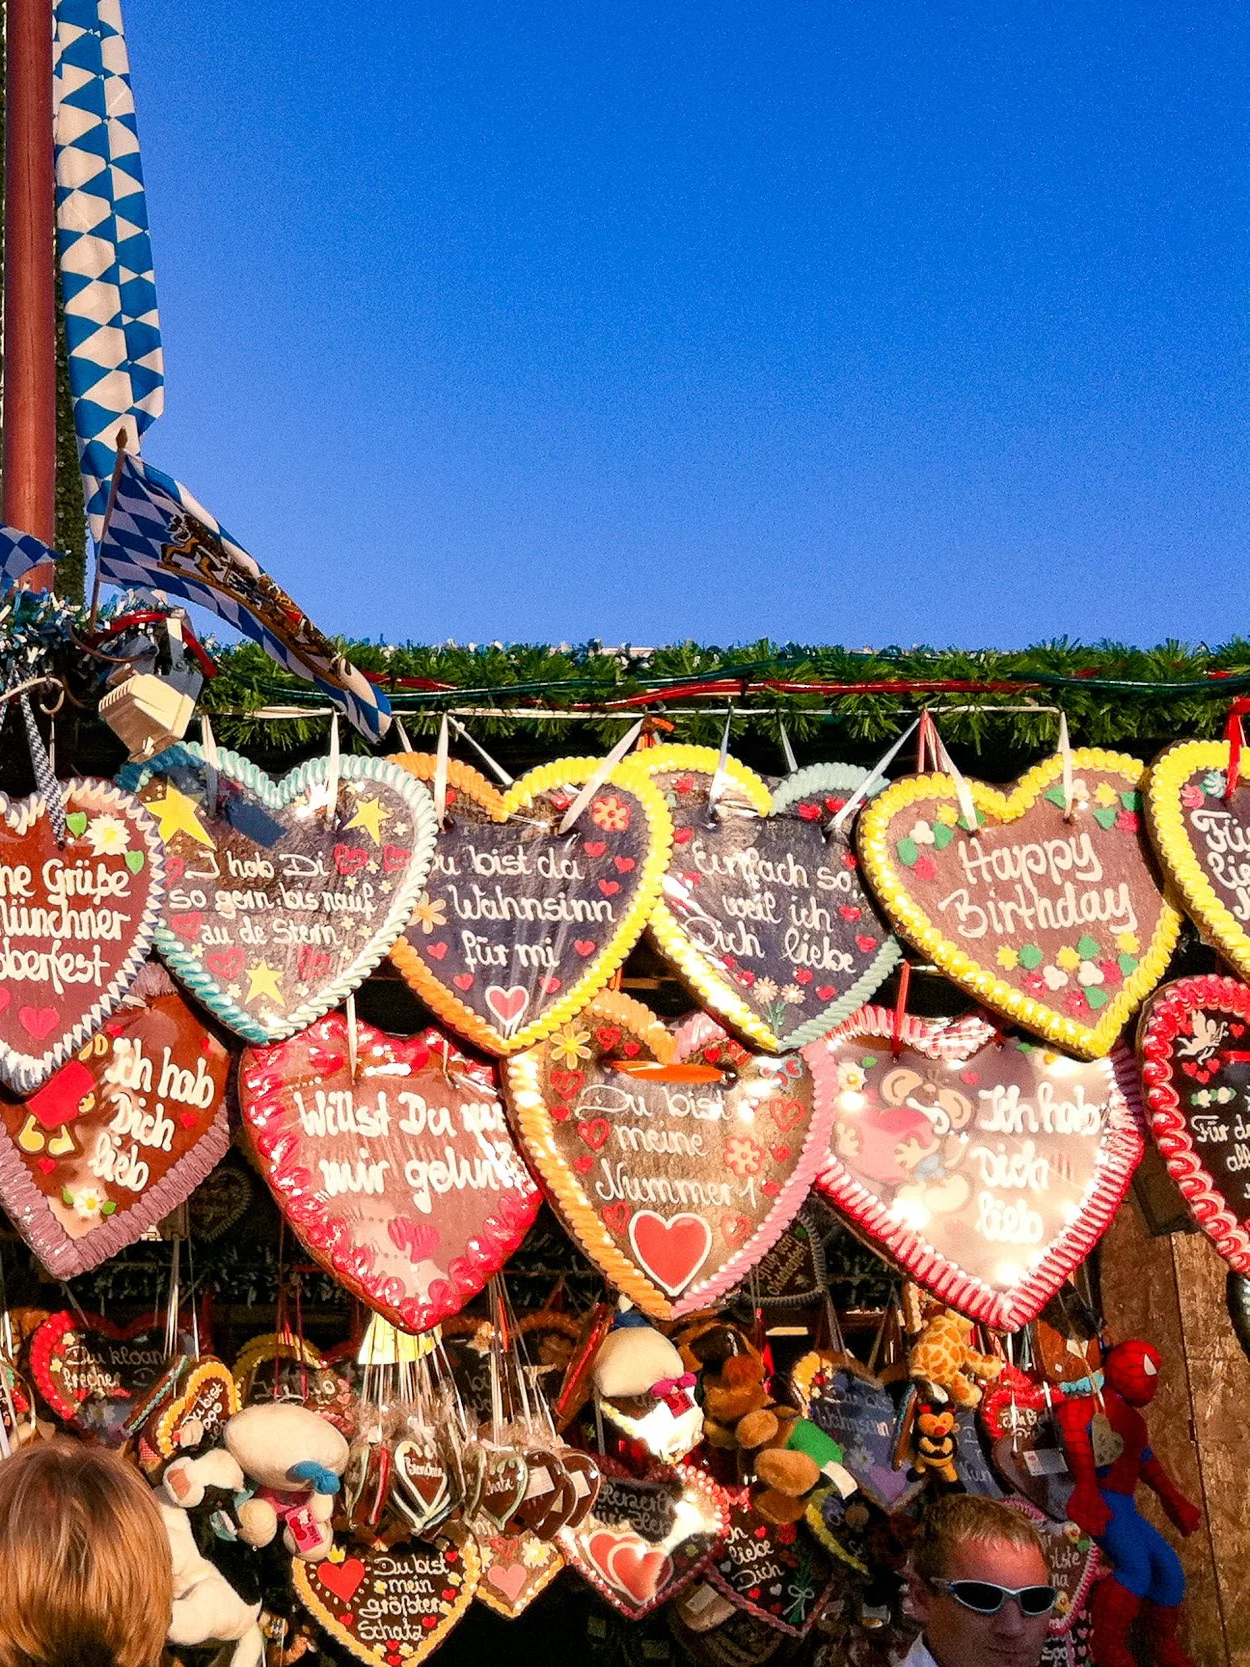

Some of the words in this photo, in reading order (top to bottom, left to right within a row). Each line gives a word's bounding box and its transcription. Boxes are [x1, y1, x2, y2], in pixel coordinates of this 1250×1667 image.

[1190, 809, 1250, 853] Fü
[279, 851, 329, 877] Di
[469, 845, 532, 877] bist
[958, 832, 1103, 886] Happy
[42, 858, 131, 905] Grüße
[169, 889, 206, 909] so
[279, 883, 319, 911] bis
[449, 884, 617, 923] Wahnsinn
[722, 891, 783, 924] weil
[790, 895, 834, 932] ich
[937, 882, 1138, 938] Birthday
[239, 916, 268, 945] de
[272, 918, 343, 946] Stern
[461, 930, 509, 974] für
[514, 937, 560, 967] mi
[684, 916, 765, 958] Dich
[158, 1046, 214, 1109] hab
[110, 1092, 175, 1152] Dich
[293, 1090, 393, 1137] Willst
[398, 1091, 457, 1137] Du
[574, 1084, 652, 1118] Du
[663, 1087, 733, 1119] bist
[978, 1085, 1039, 1134] Ich
[1038, 1082, 1101, 1135] hab
[614, 1120, 708, 1157] meine
[1191, 1115, 1229, 1142] Für
[88, 1132, 149, 1192] lieb
[319, 1147, 389, 1197] mir
[971, 1140, 1050, 1189] Dich
[596, 1158, 739, 1206] Nummer
[739, 1176, 757, 1209] 1
[374, 1557, 413, 1575] Du
[411, 1552, 449, 1575] bist
[389, 1575, 435, 1593] mein
[731, 1561, 785, 1591] Dich
[358, 1617, 425, 1640] Schatz
